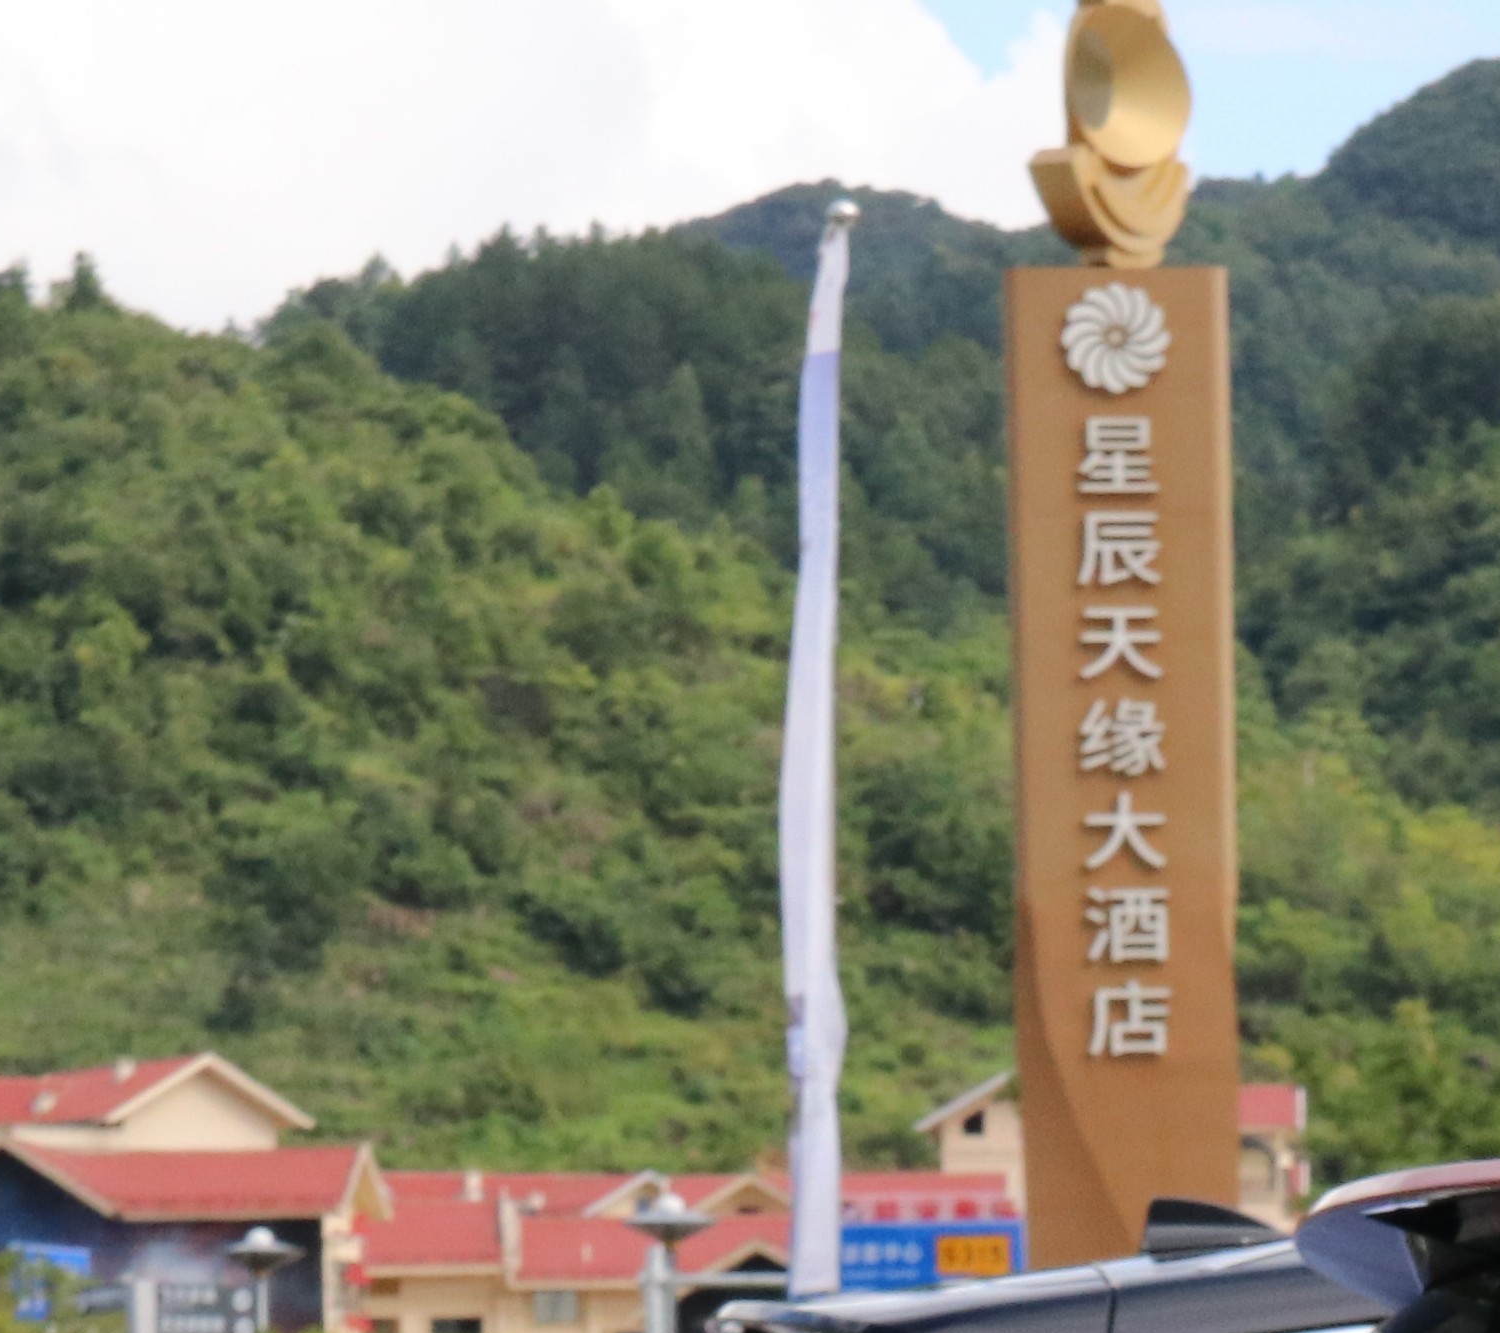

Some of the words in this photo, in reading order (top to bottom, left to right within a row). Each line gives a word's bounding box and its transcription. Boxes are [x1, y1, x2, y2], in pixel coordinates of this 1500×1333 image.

[1077, 415, 1172, 1058] 星辰天缘大酒店
